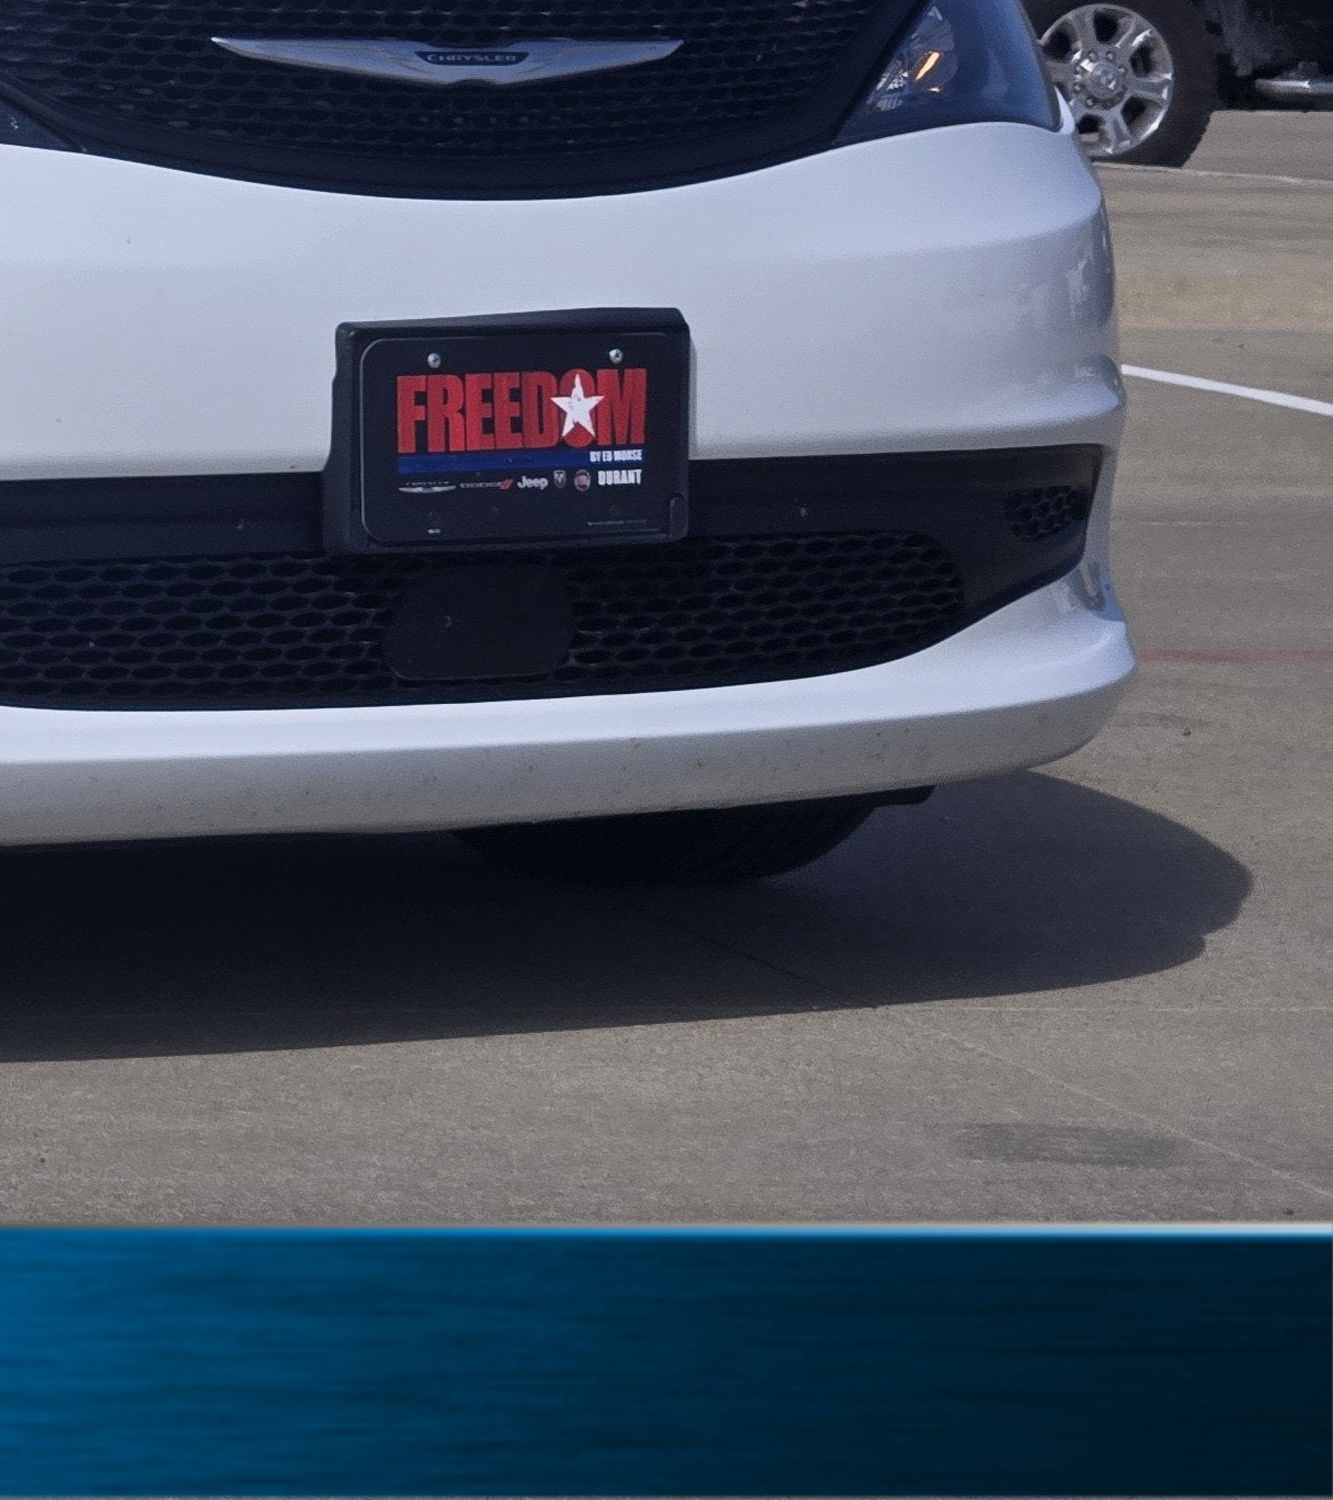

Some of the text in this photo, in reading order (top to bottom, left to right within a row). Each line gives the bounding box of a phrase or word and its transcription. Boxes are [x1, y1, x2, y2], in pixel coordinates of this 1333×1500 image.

[396, 368, 647, 453] FREEDOM
[516, 475, 549, 491] Jeep
[597, 469, 643, 486] DURANT
